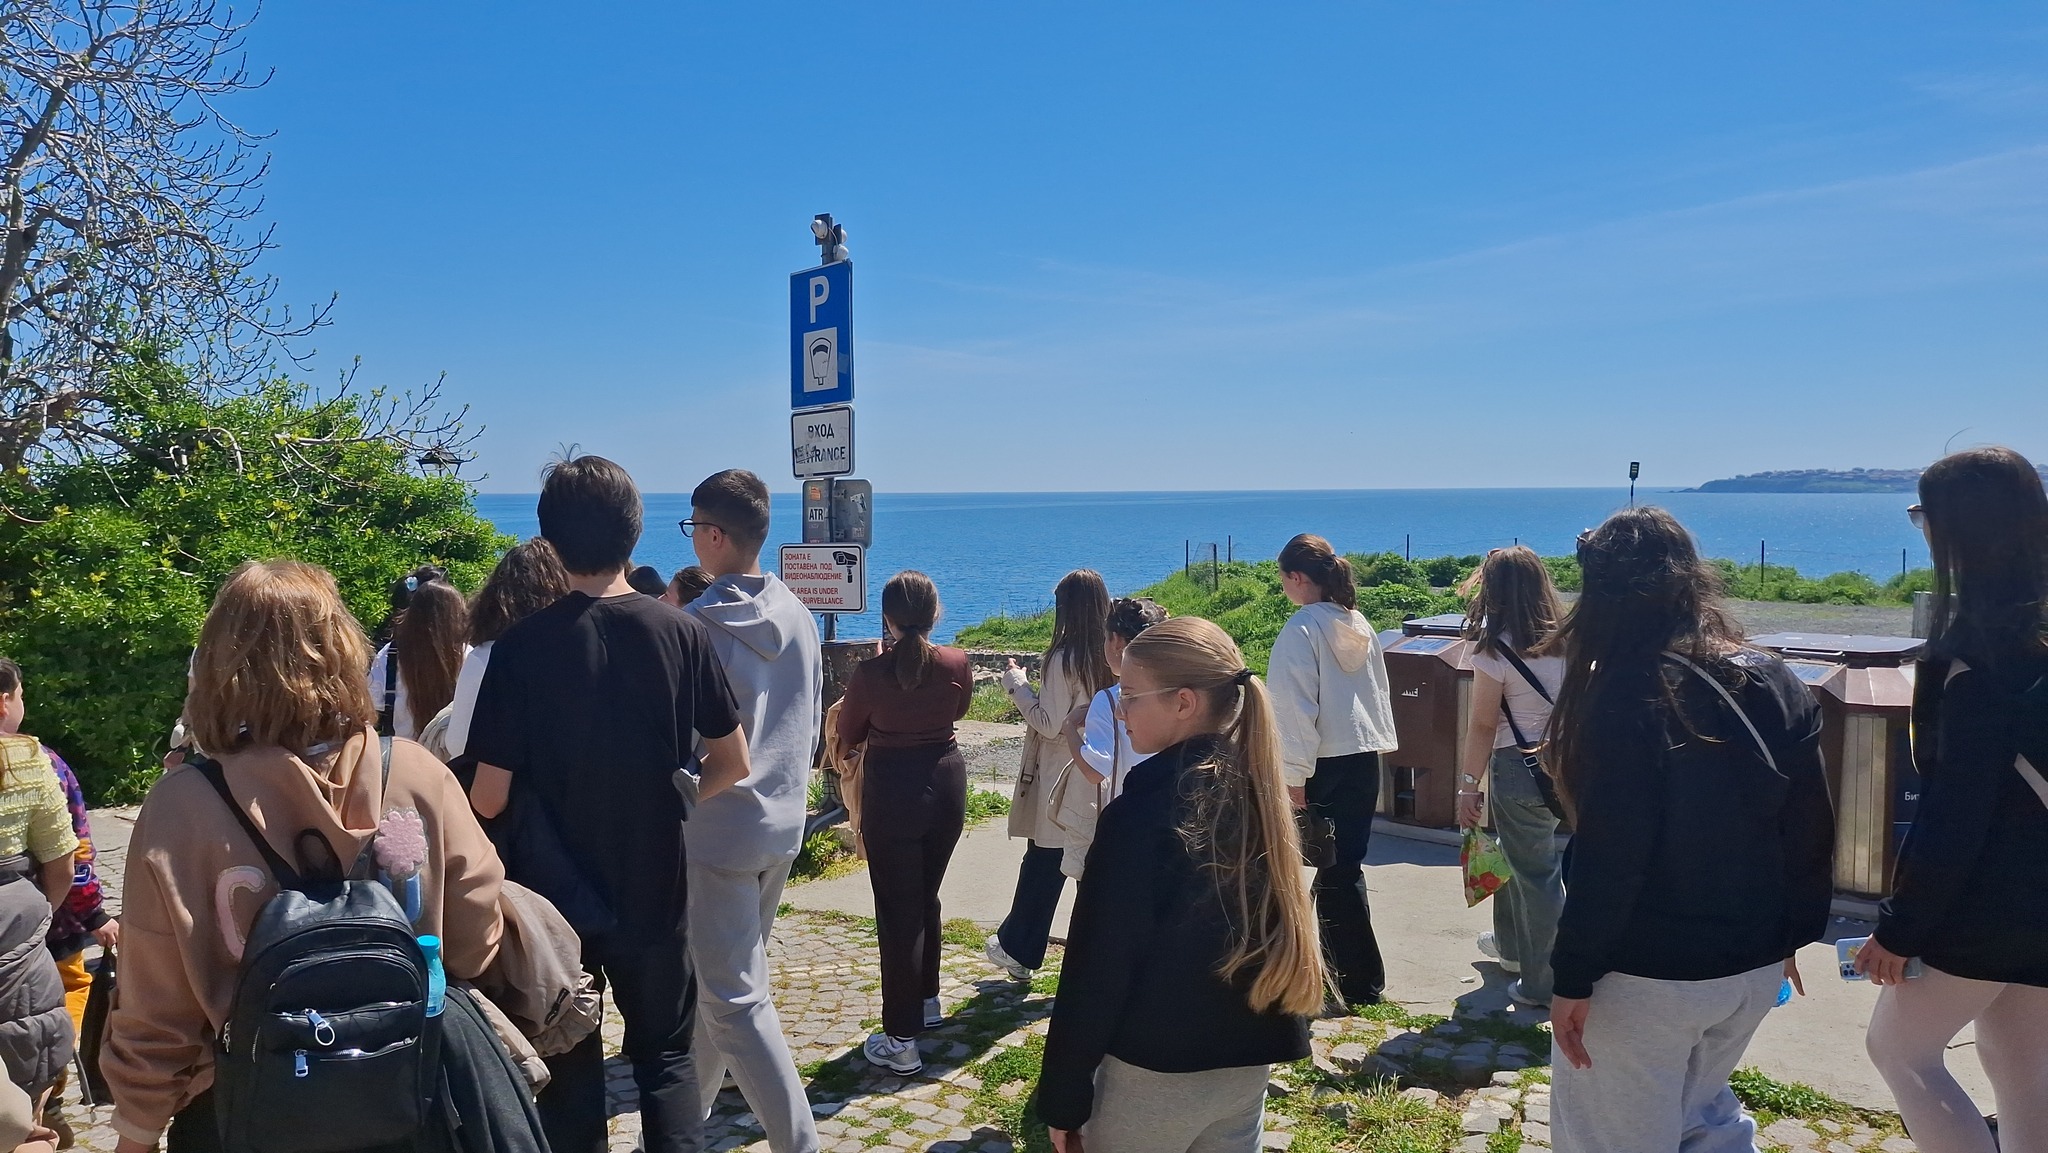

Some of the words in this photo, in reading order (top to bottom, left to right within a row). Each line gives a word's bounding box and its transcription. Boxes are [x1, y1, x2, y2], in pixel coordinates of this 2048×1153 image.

[810, 275, 829, 324] P
[807, 423, 835, 439] ВХОД
[809, 508, 823, 521] ATR
[784, 553, 806, 561] ЗОНАТА
[820, 563, 832, 571] ПОД
[784, 572, 842, 581] ВИДЕОНАБЛЮДЕНИЕ
[797, 587, 811, 595] AREA
[812, 587, 818, 595] IS
[819, 587, 839, 595] UNDER
[803, 597, 843, 605] SURVEILLANCE
